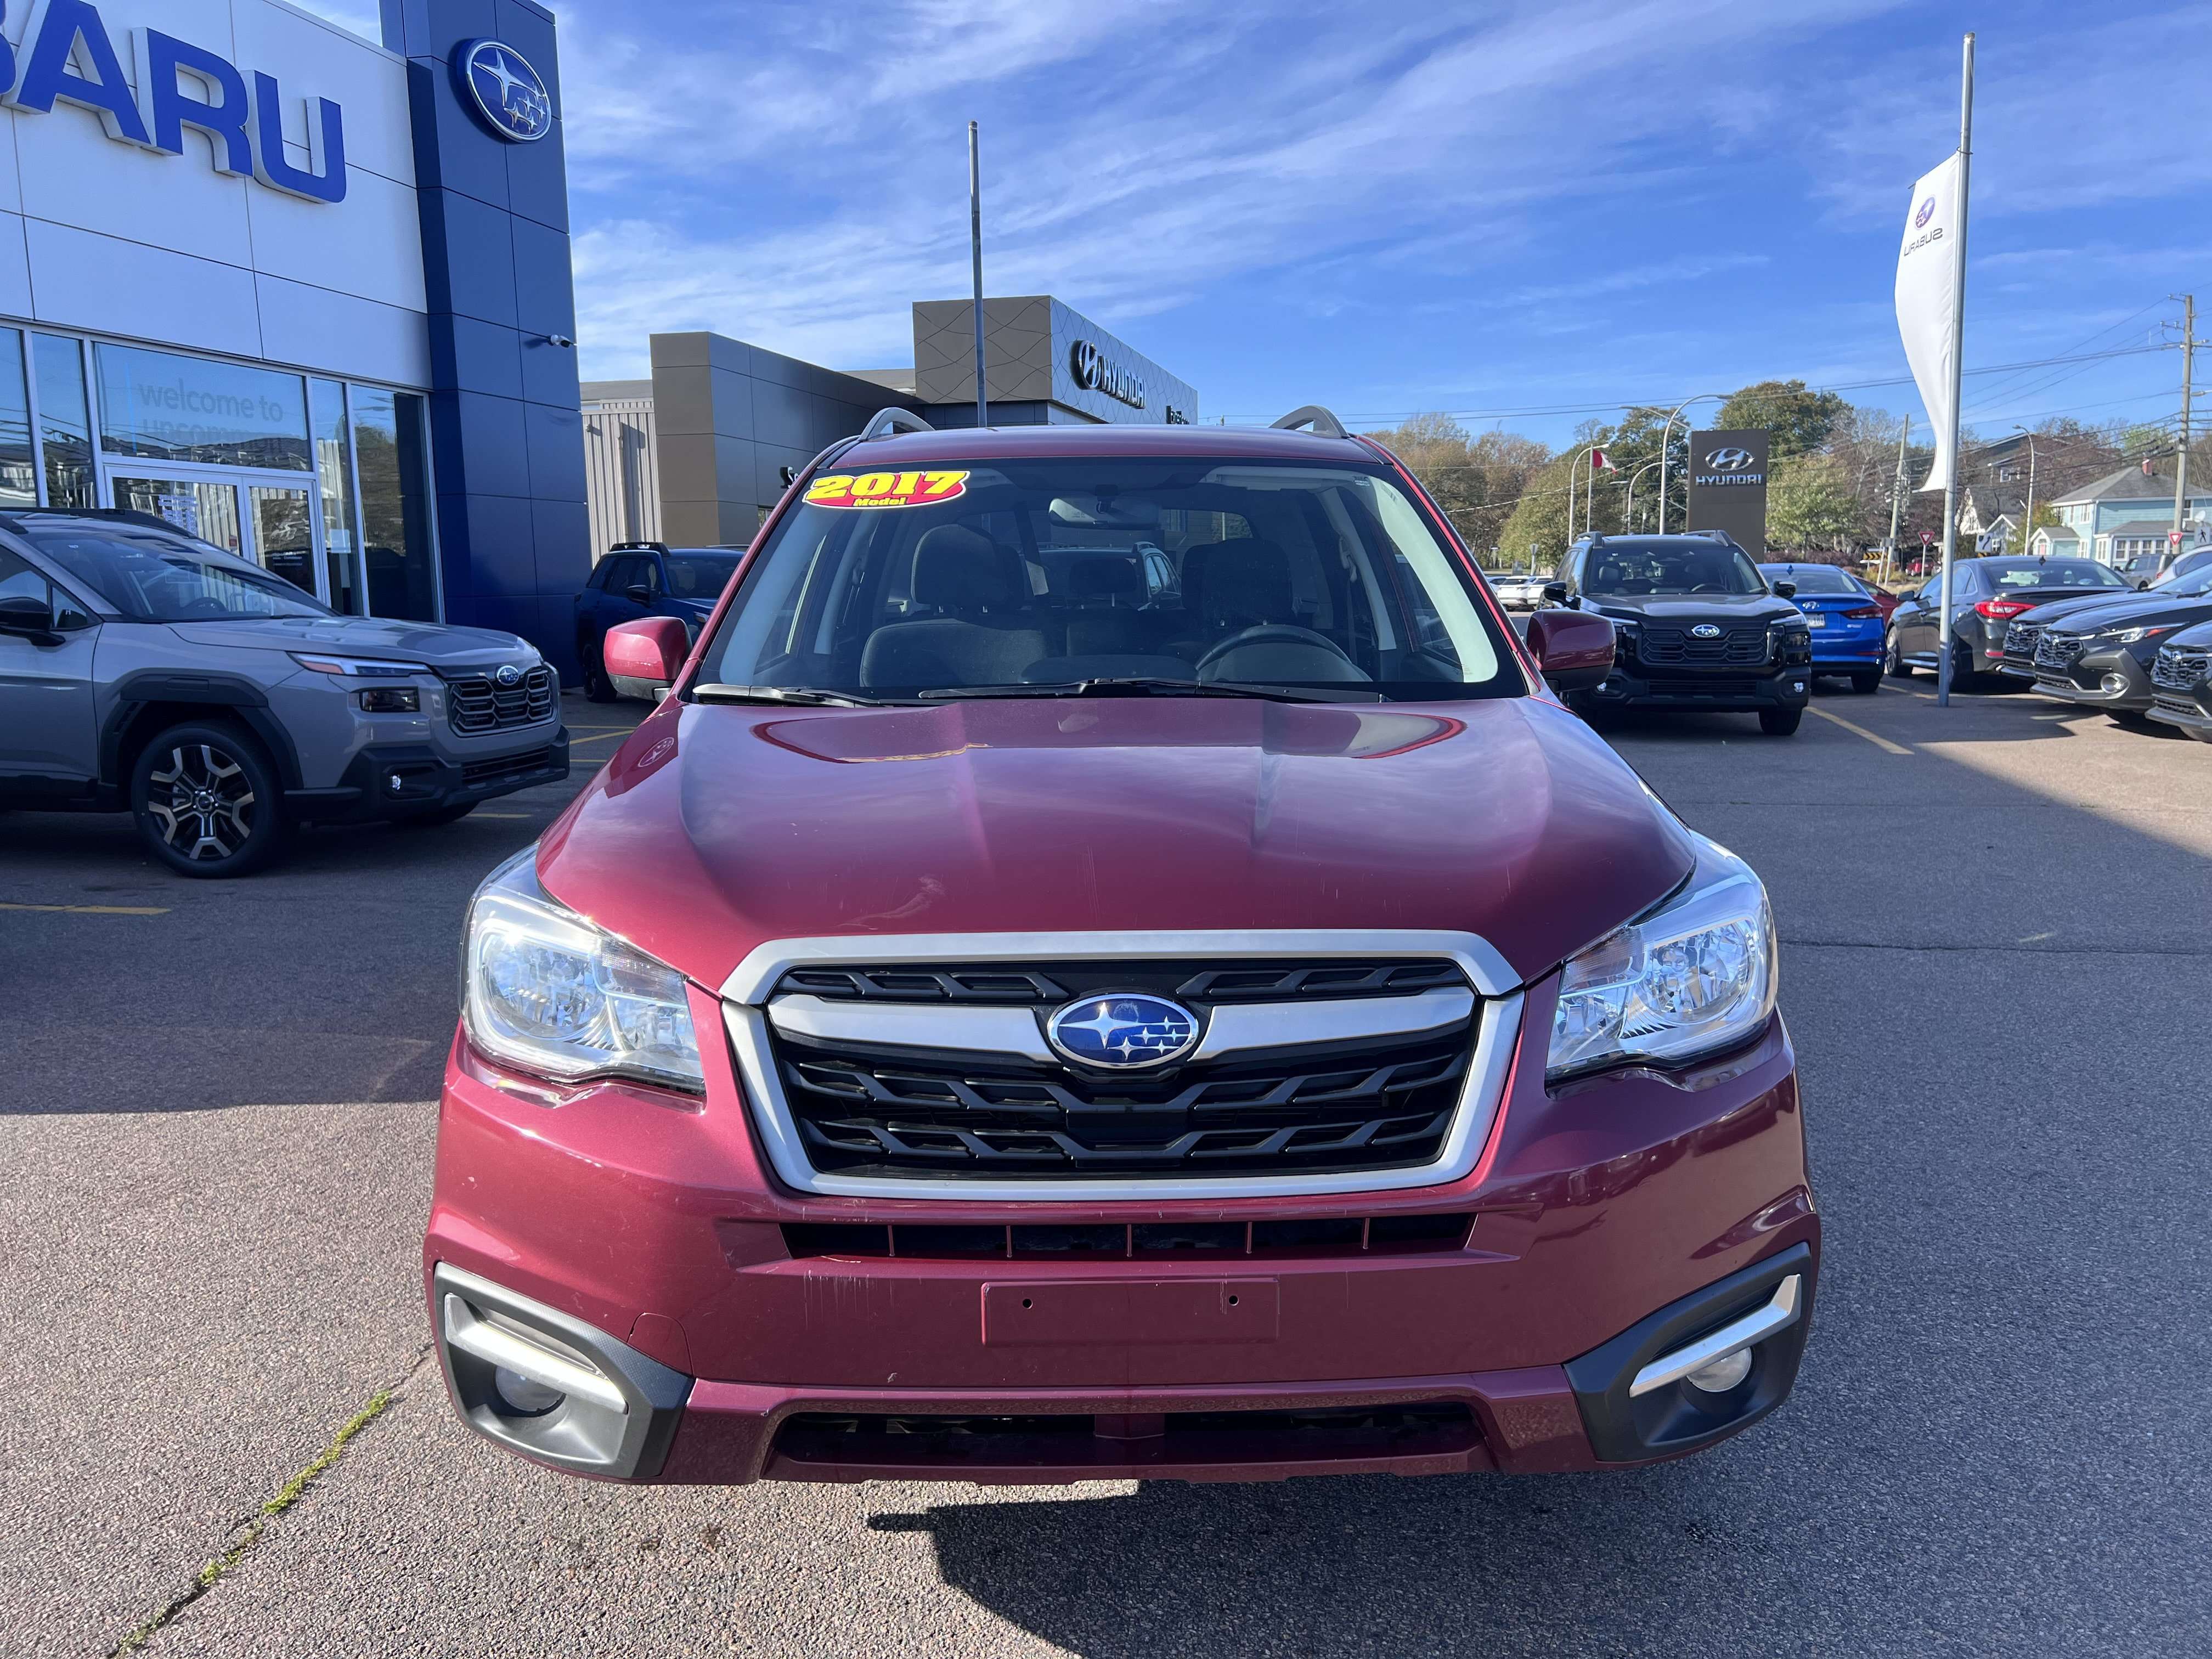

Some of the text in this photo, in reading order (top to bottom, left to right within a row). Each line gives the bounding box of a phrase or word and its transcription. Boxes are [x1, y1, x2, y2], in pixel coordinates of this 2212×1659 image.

[0, 0, 347, 204] ARU
[137, 377, 283, 422] welcome to
[1101, 356, 1146, 409] HYUNDAI
[805, 472, 967, 500] 2017
[1695, 473, 1762, 486] HYUNDAI
[853, 496, 907, 506] Model
